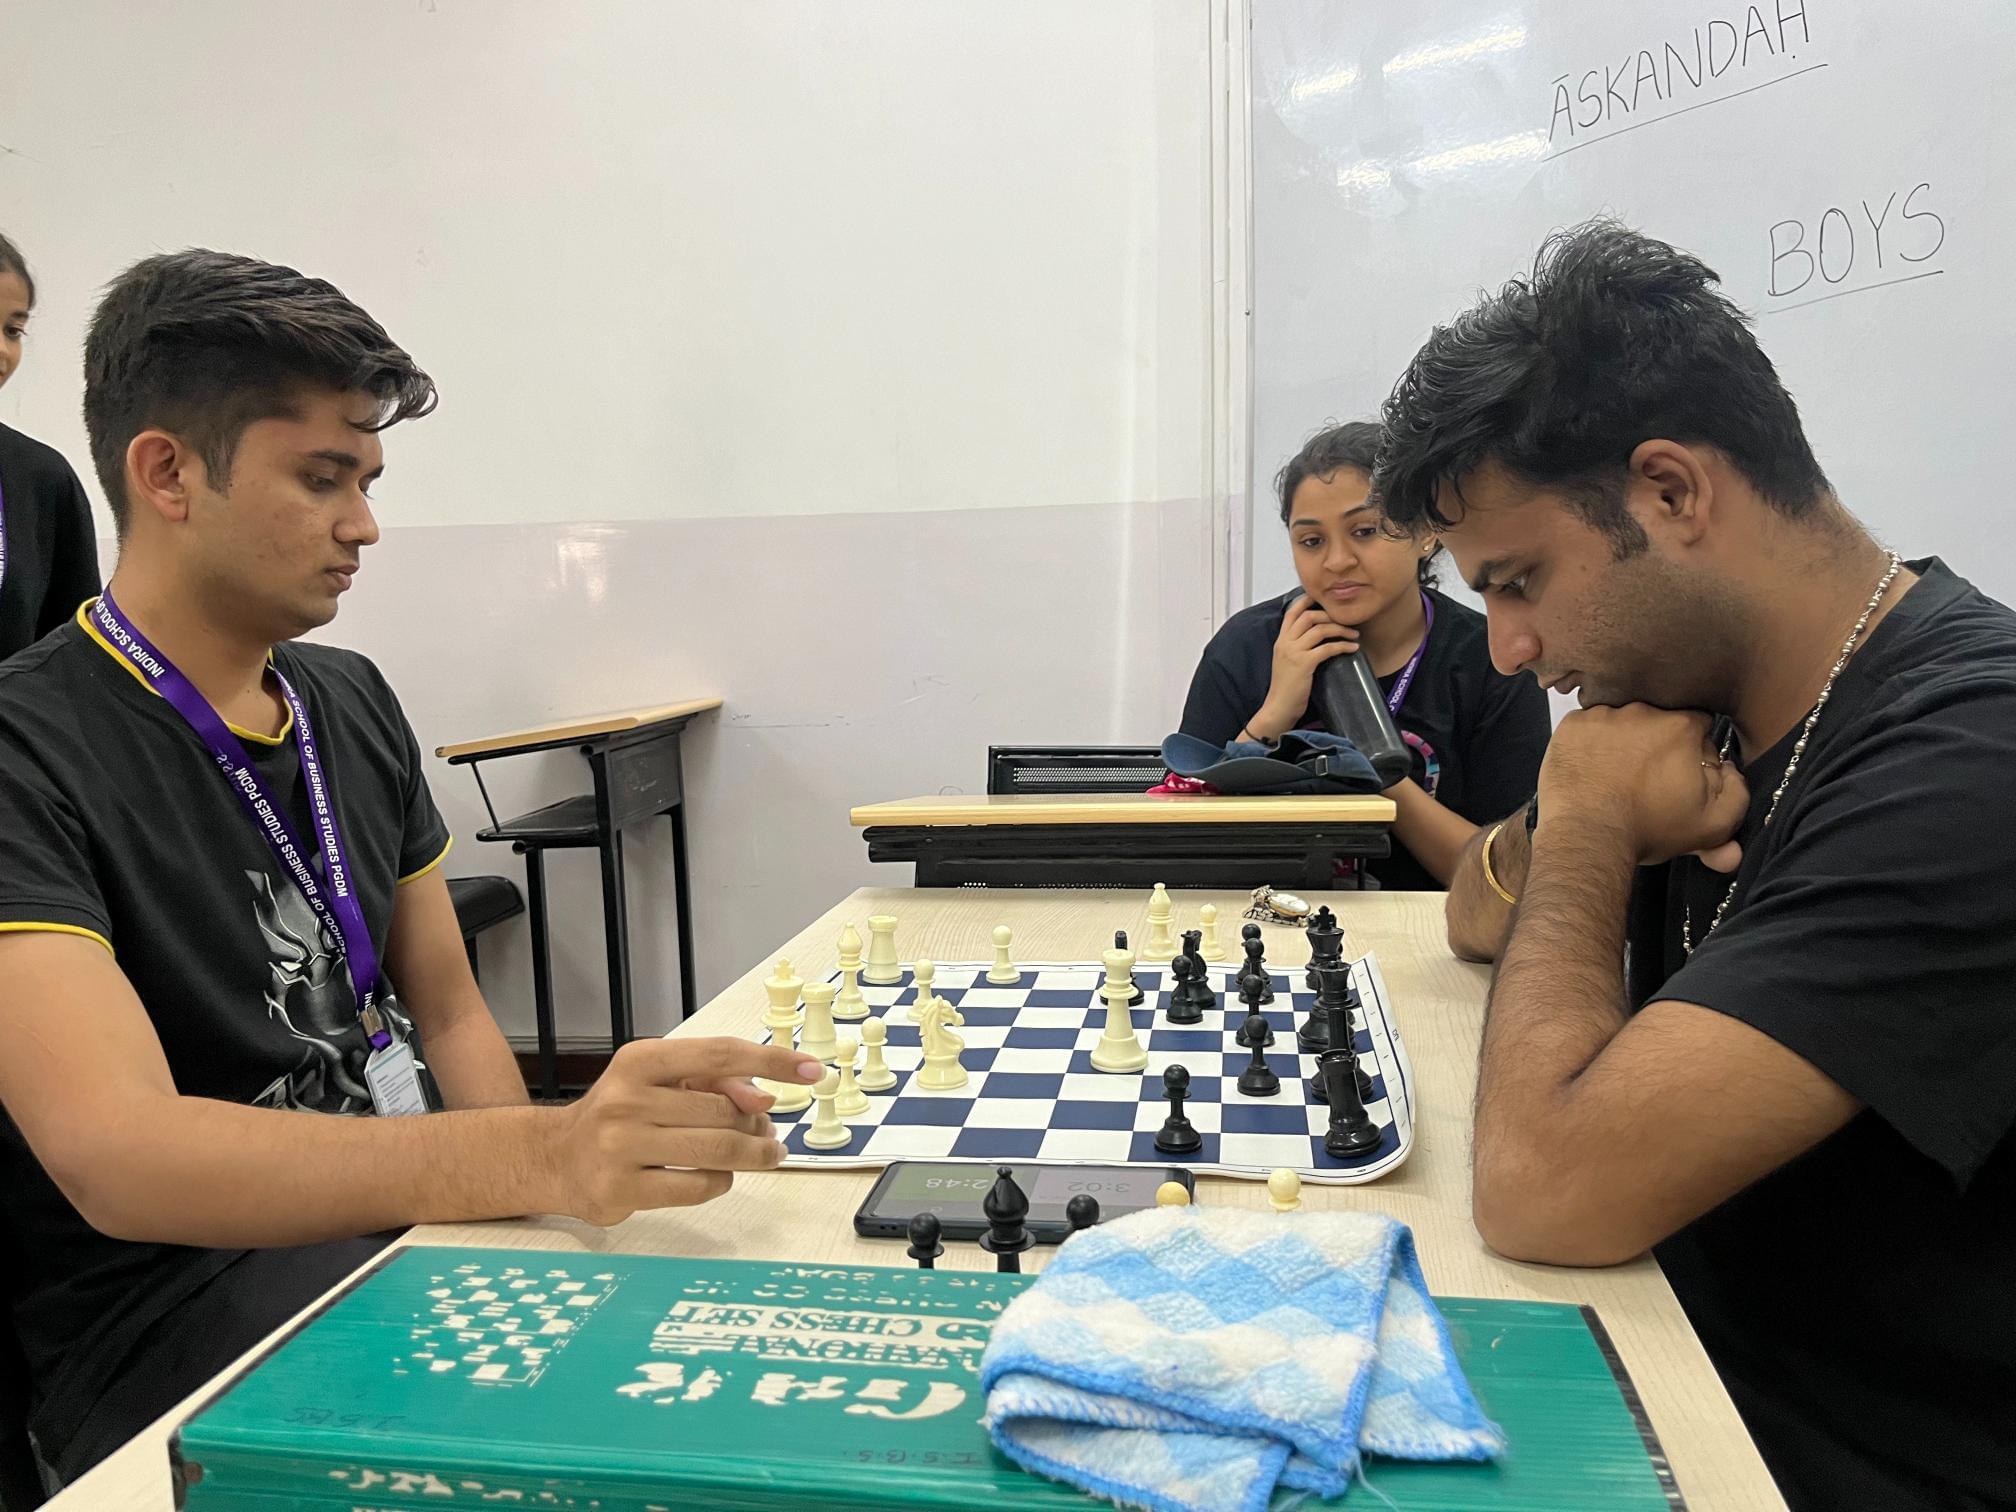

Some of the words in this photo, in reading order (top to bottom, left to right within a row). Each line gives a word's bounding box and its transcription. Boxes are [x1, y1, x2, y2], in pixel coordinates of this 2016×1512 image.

[1767, 183, 1945, 297] BOYS
[98, 609, 132, 646] SCHOOL
[127, 641, 166, 678] INDIRA
[292, 699, 311, 743] SCHOOL
[304, 745, 314, 760] OF
[234, 767, 262, 801] PGDM
[307, 762, 328, 815] BUSINESS
[254, 799, 289, 844] STUDIES
[320, 817, 340, 863] STUDIES
[281, 844, 318, 895] BUSINESS
[331, 864, 348, 897] PGDM
[310, 897, 325, 912] OF
[925, 1177, 989, 1190] 2:48
[1067, 1180, 1131, 1193] 3:02
[680, 1306, 764, 1329] SET
[769, 1312, 923, 1338] CHESS
